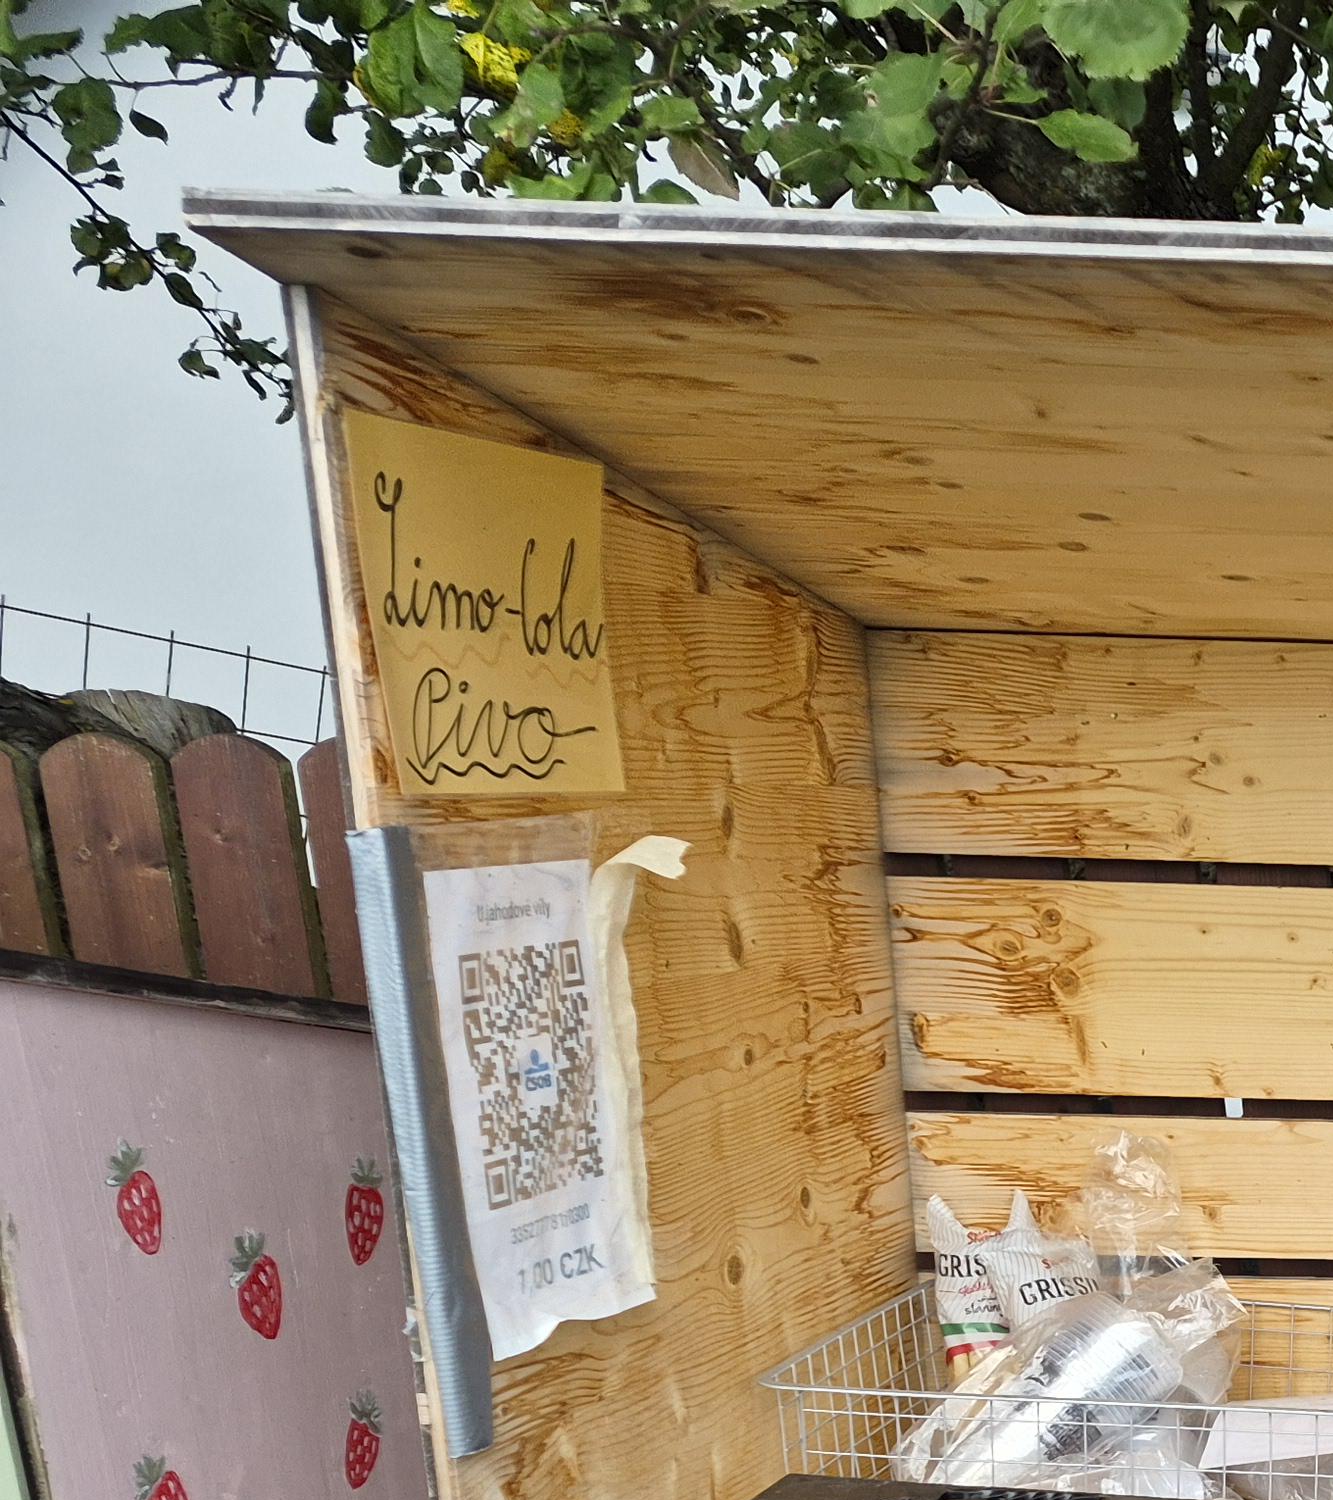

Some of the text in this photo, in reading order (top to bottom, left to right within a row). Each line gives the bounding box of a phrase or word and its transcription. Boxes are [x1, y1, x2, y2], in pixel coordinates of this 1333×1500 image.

[412, 668, 596, 769] Pivo
[560, 1243, 607, 1279] CZK
[938, 1253, 987, 1278] GRIS
